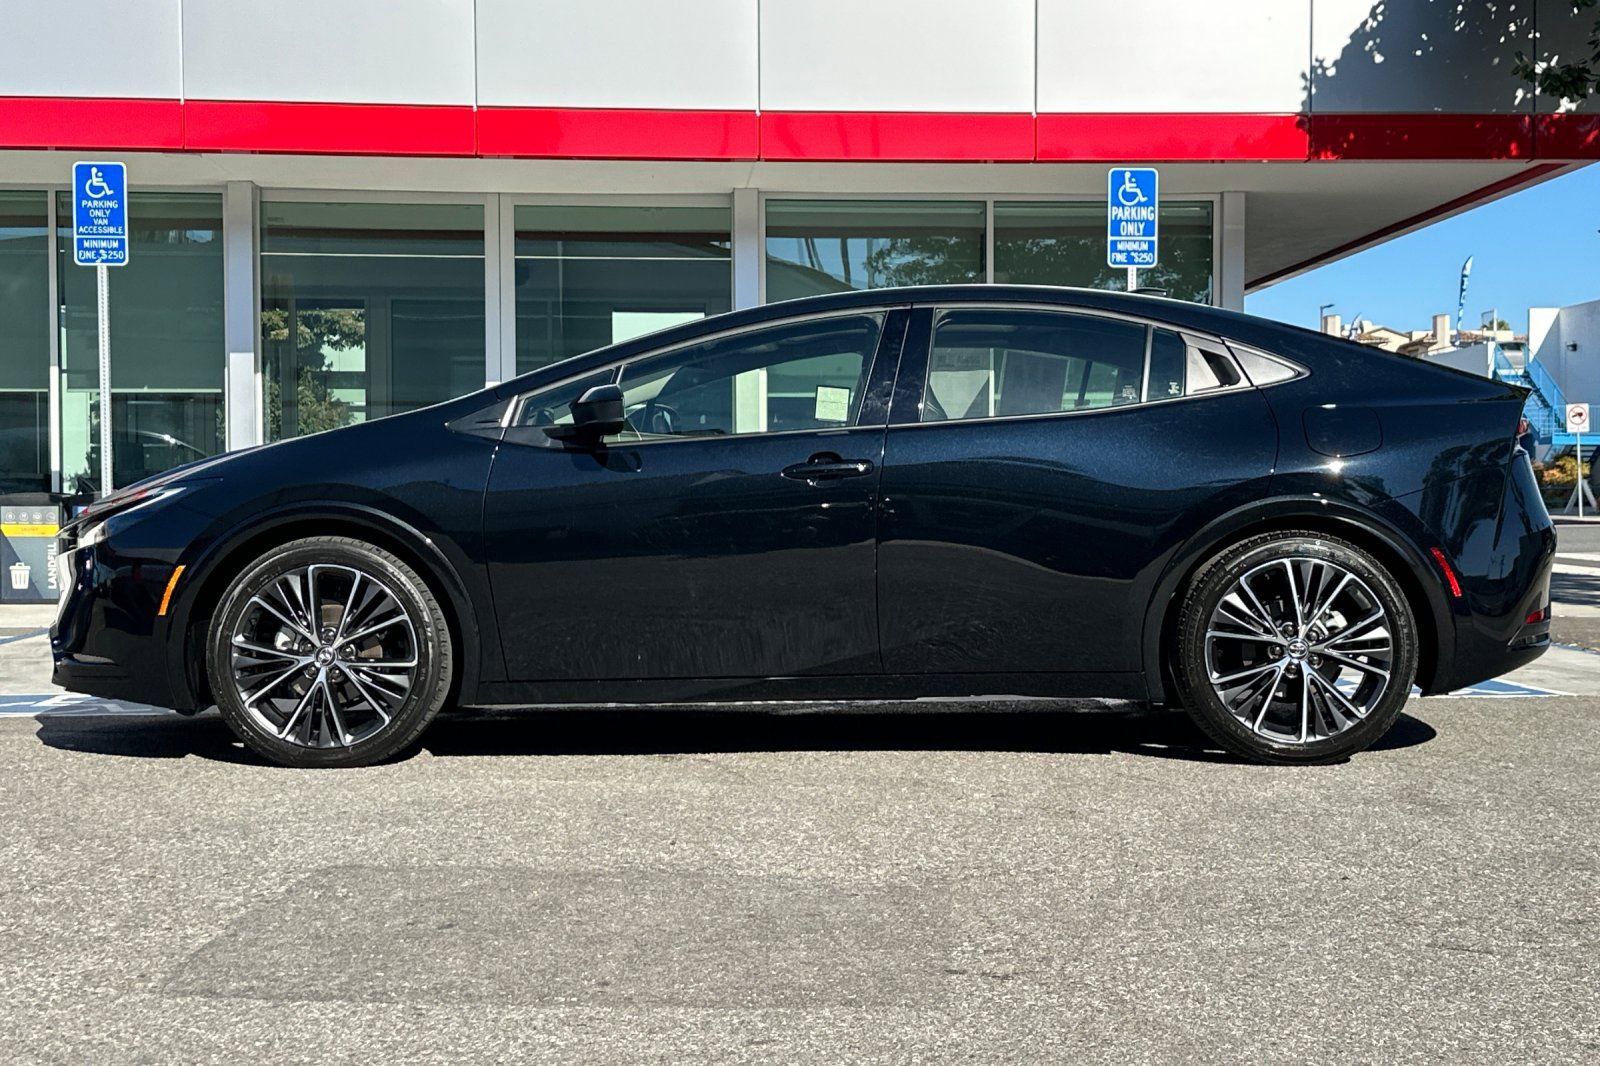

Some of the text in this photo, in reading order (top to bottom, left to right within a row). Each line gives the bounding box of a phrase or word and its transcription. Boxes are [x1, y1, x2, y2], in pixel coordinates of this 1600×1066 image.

[81, 199, 119, 209] PARKING
[89, 209, 111, 218] ONLY
[1111, 206, 1155, 221] PARKING
[93, 218, 109, 226] VAN
[78, 226, 124, 234] ACCESSIBLE
[1120, 221, 1145, 236] ONLY
[83, 240, 119, 249] MINIMUM
[1116, 241, 1149, 251] MINIMUM
[78, 249, 125, 260] FINE $250
[1111, 252, 1154, 263] FINE $250
[47, 541, 58, 590] LANDFILL
